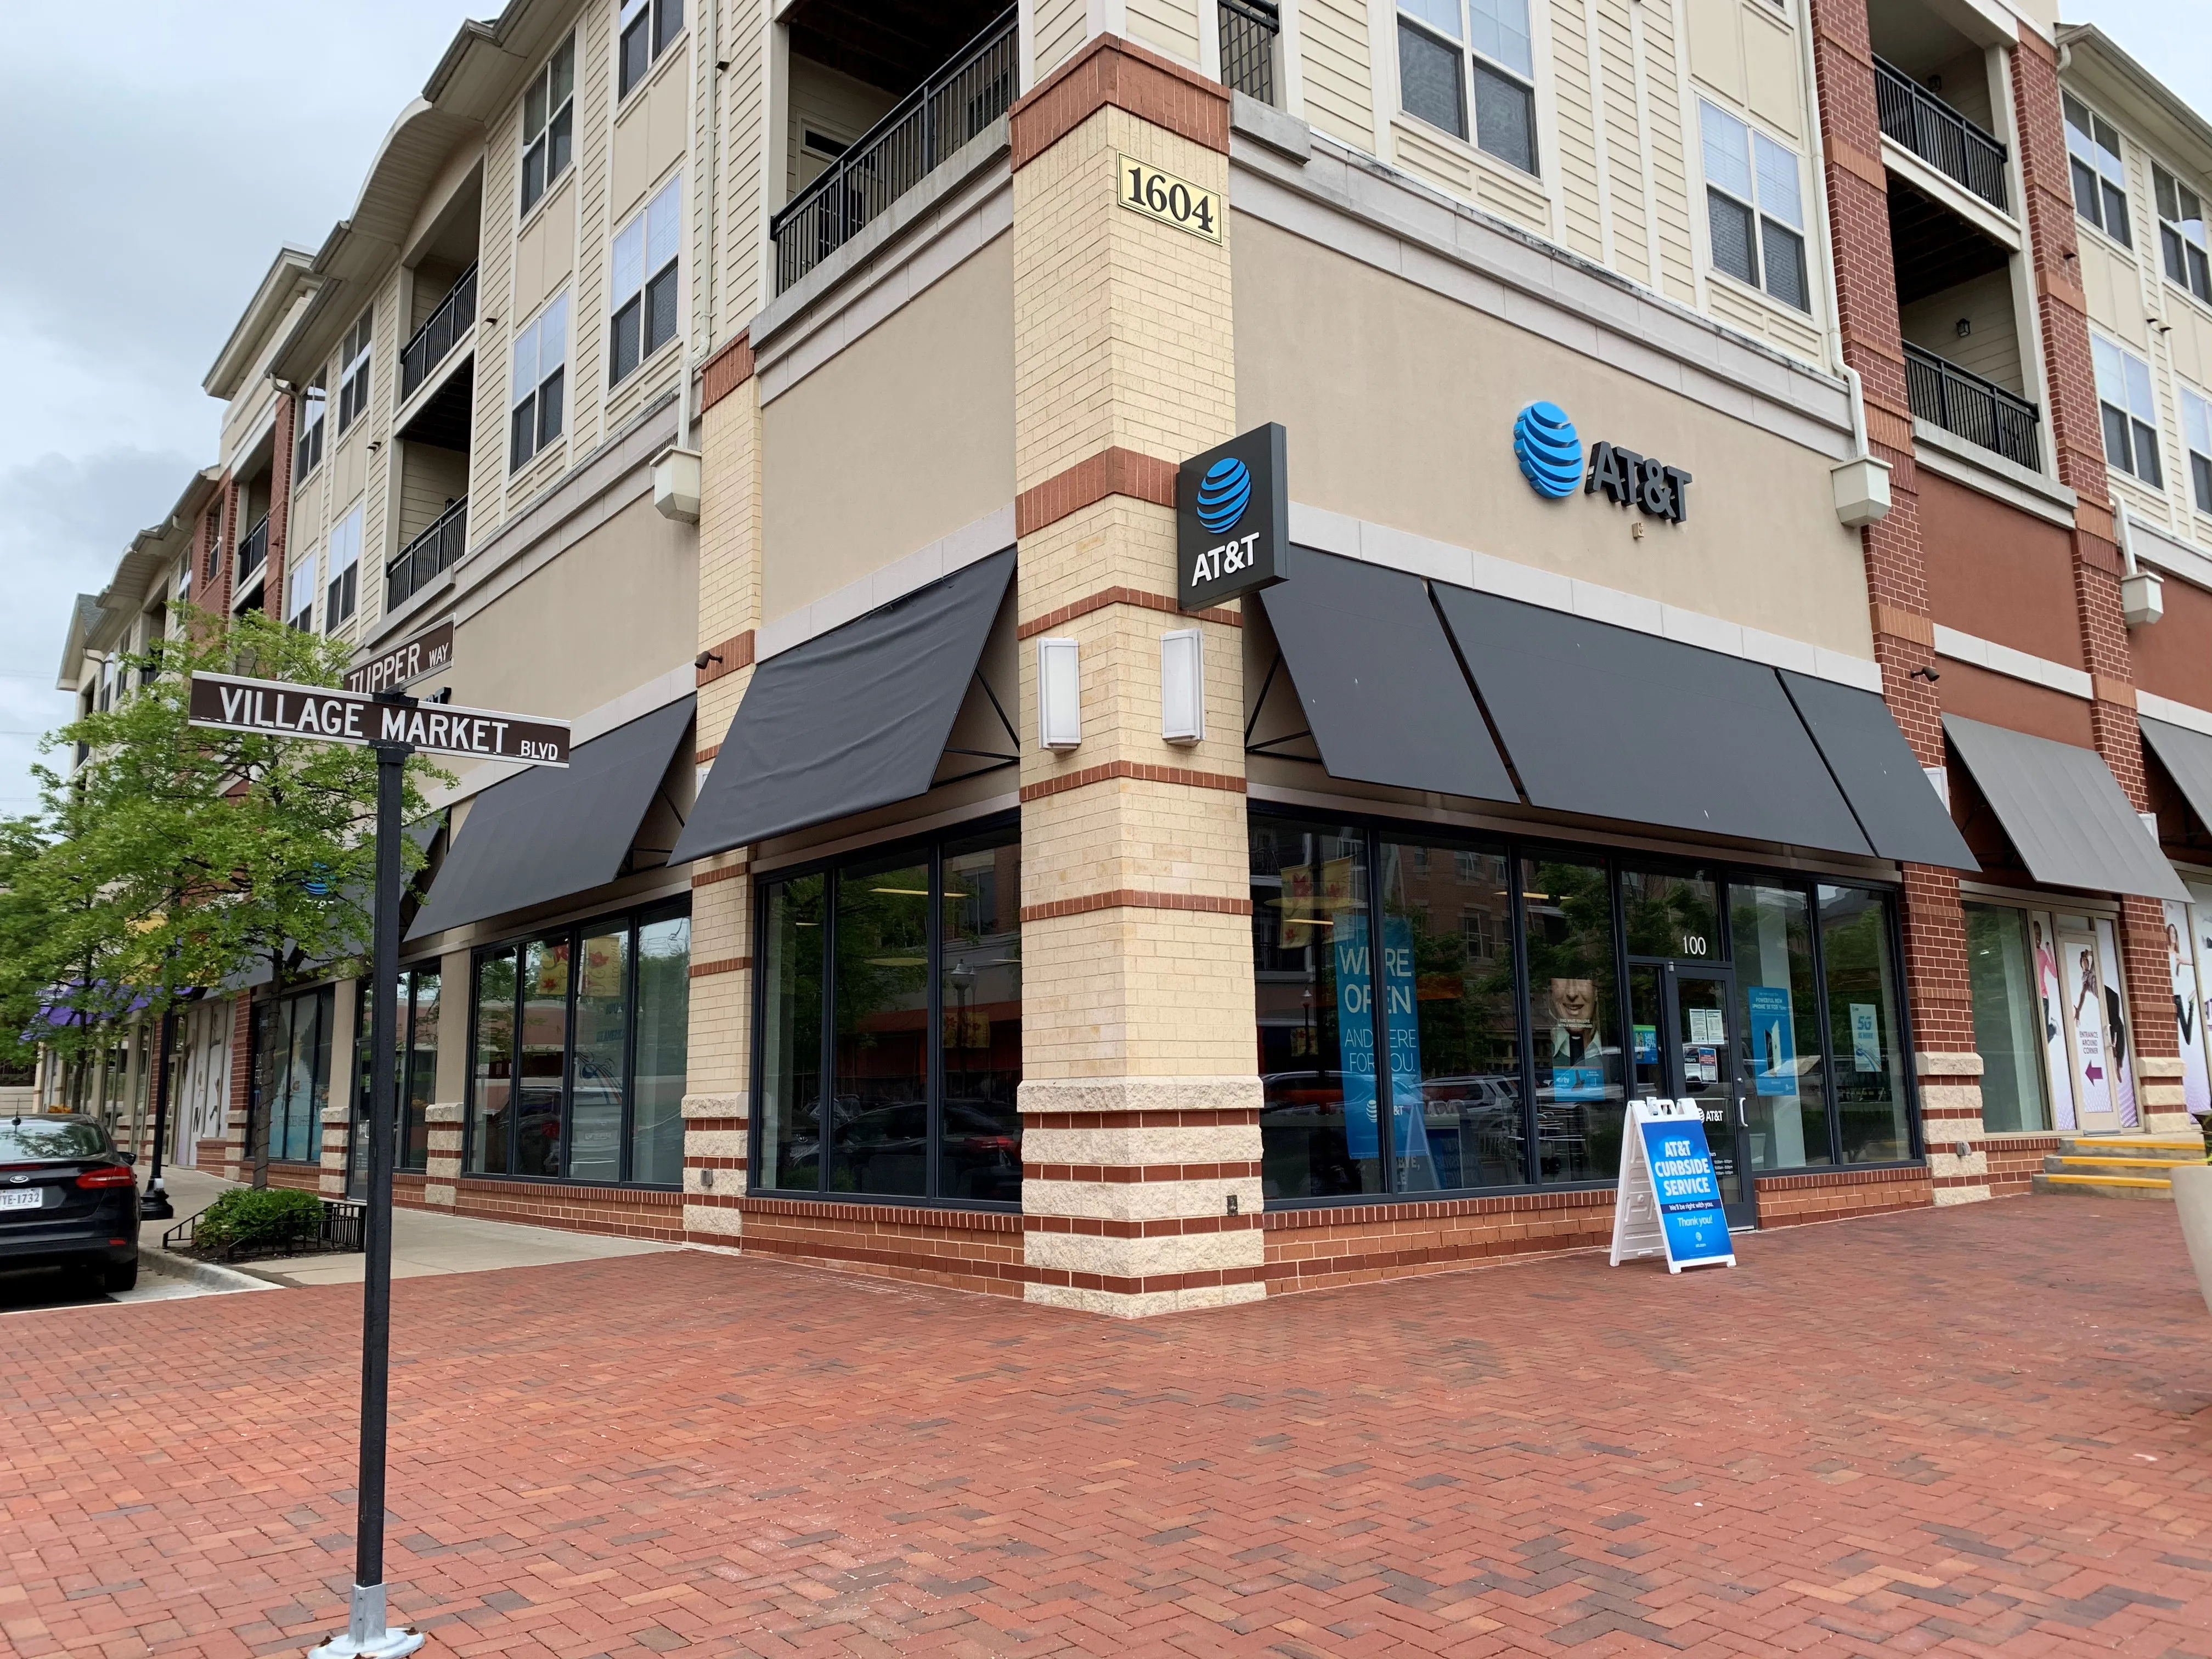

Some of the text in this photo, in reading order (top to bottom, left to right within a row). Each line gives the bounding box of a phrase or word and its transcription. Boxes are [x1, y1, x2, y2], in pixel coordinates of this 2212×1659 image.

[1128, 166, 1214, 234] 1604
[1584, 441, 1692, 524] AT&T
[1192, 532, 1260, 587] AT&T
[349, 642, 449, 694] TUPPER WAY
[219, 686, 558, 761] VILLAGE MARKET BLVD
[1683, 935, 1706, 955] 100
[1345, 1028, 1417, 1048] AND ERE
[1350, 1053, 1415, 1073] FOR OU.
[1706, 1110, 1723, 1121] AT&T
[1664, 1140, 1691, 1158] AT&T
[1655, 1158, 1711, 1178] CURBSIDE
[1663, 1177, 1711, 1197] SERVICE
[1685, 1203, 1695, 1211] right
[1677, 1214, 1713, 1227] Thank you!
